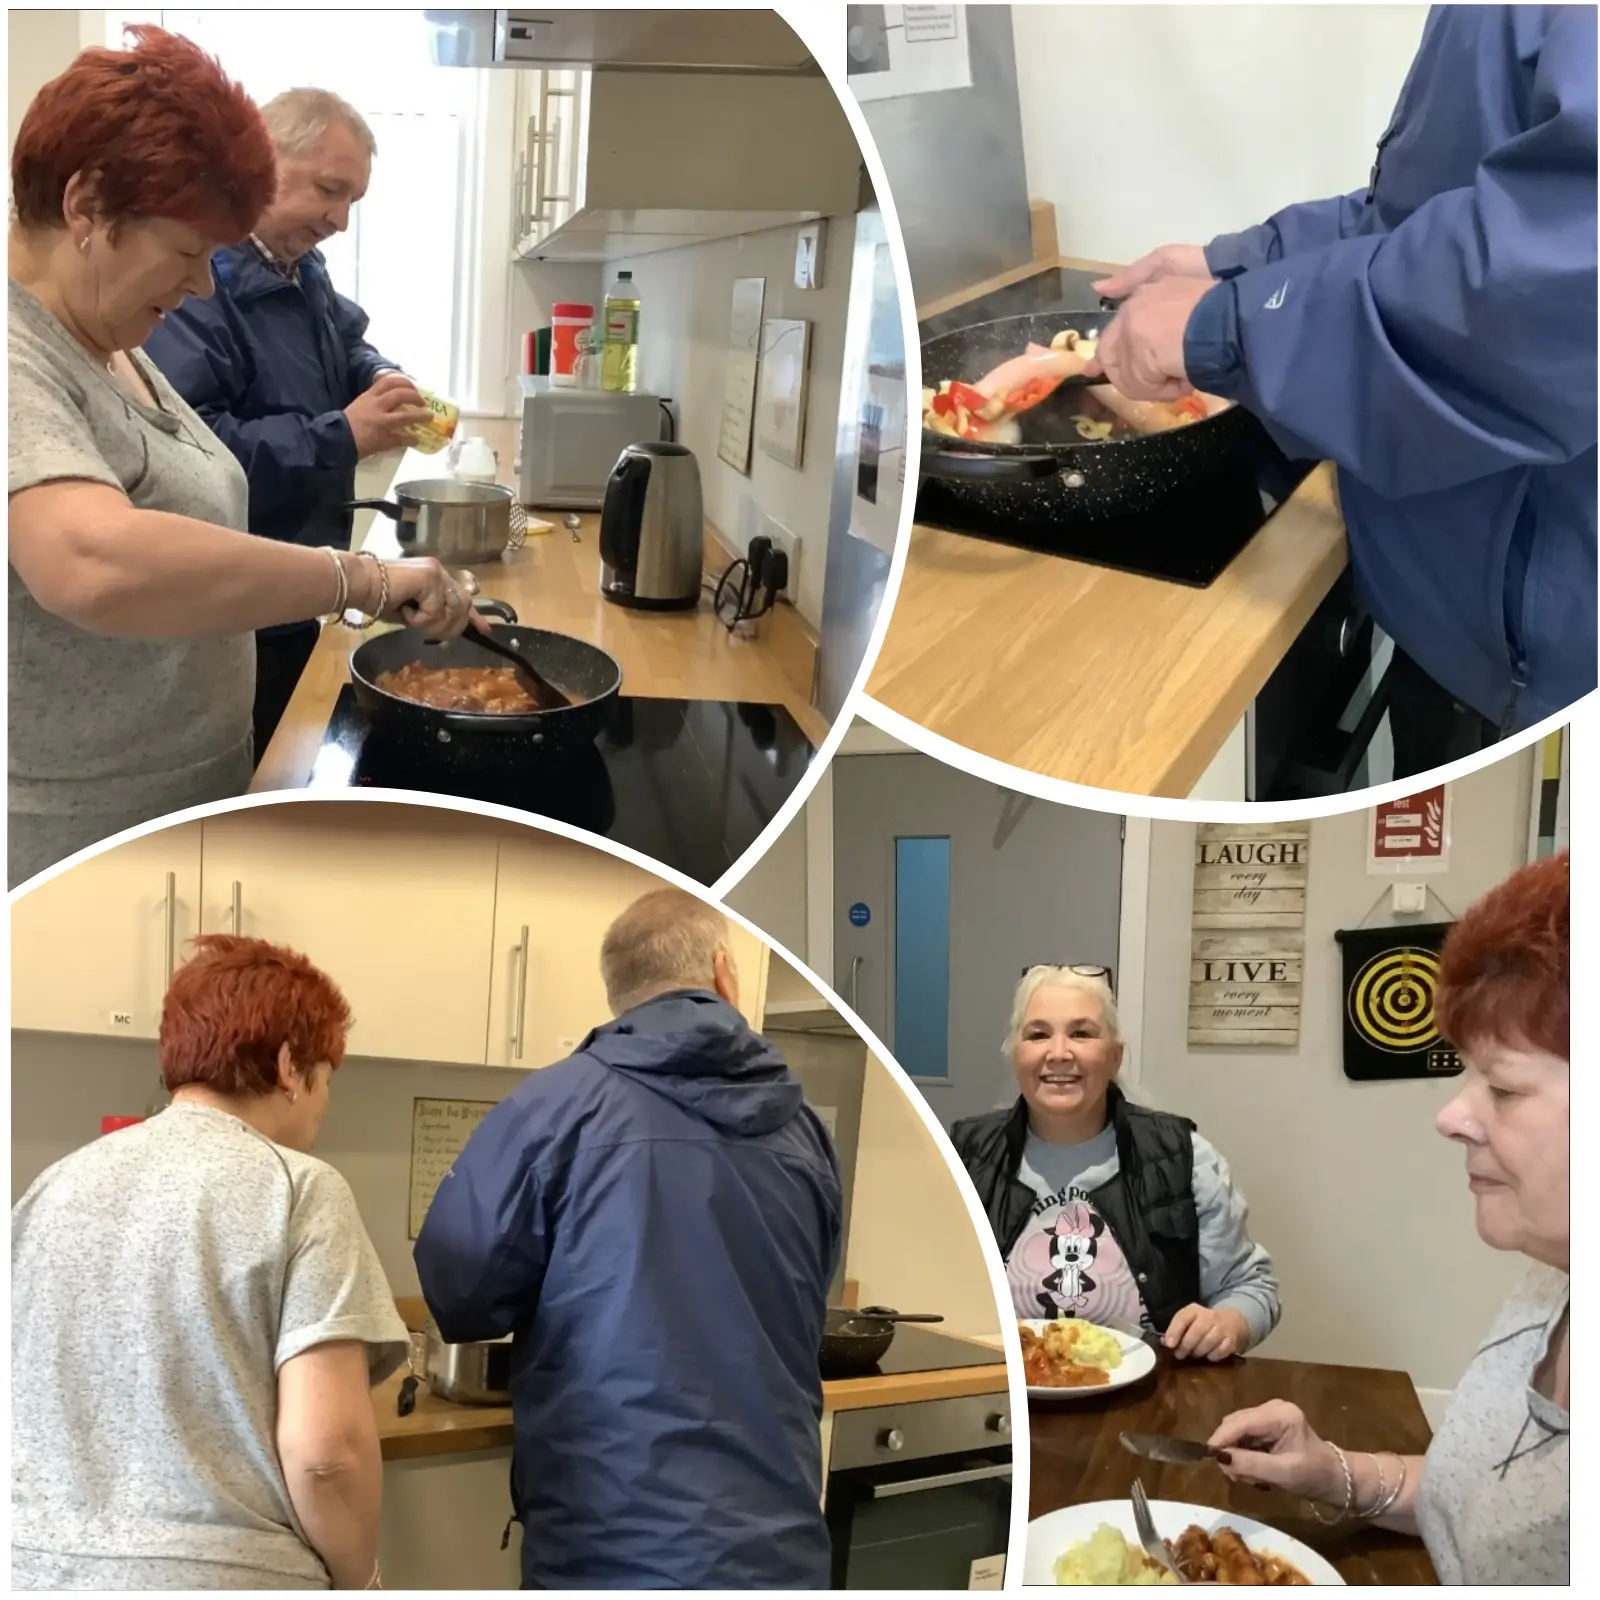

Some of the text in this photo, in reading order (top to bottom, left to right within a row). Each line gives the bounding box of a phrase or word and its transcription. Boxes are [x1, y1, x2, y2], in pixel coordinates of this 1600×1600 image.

[1199, 843, 1300, 865] LAUGH
[1230, 871, 1267, 887] every
[1233, 885, 1262, 904] day
[1203, 961, 1288, 982] LIVE
[1223, 990, 1261, 1005] every
[114, 1014, 131, 1025] MC
[1212, 1006, 1272, 1018] moment
[1068, 1186, 1093, 1205] po
